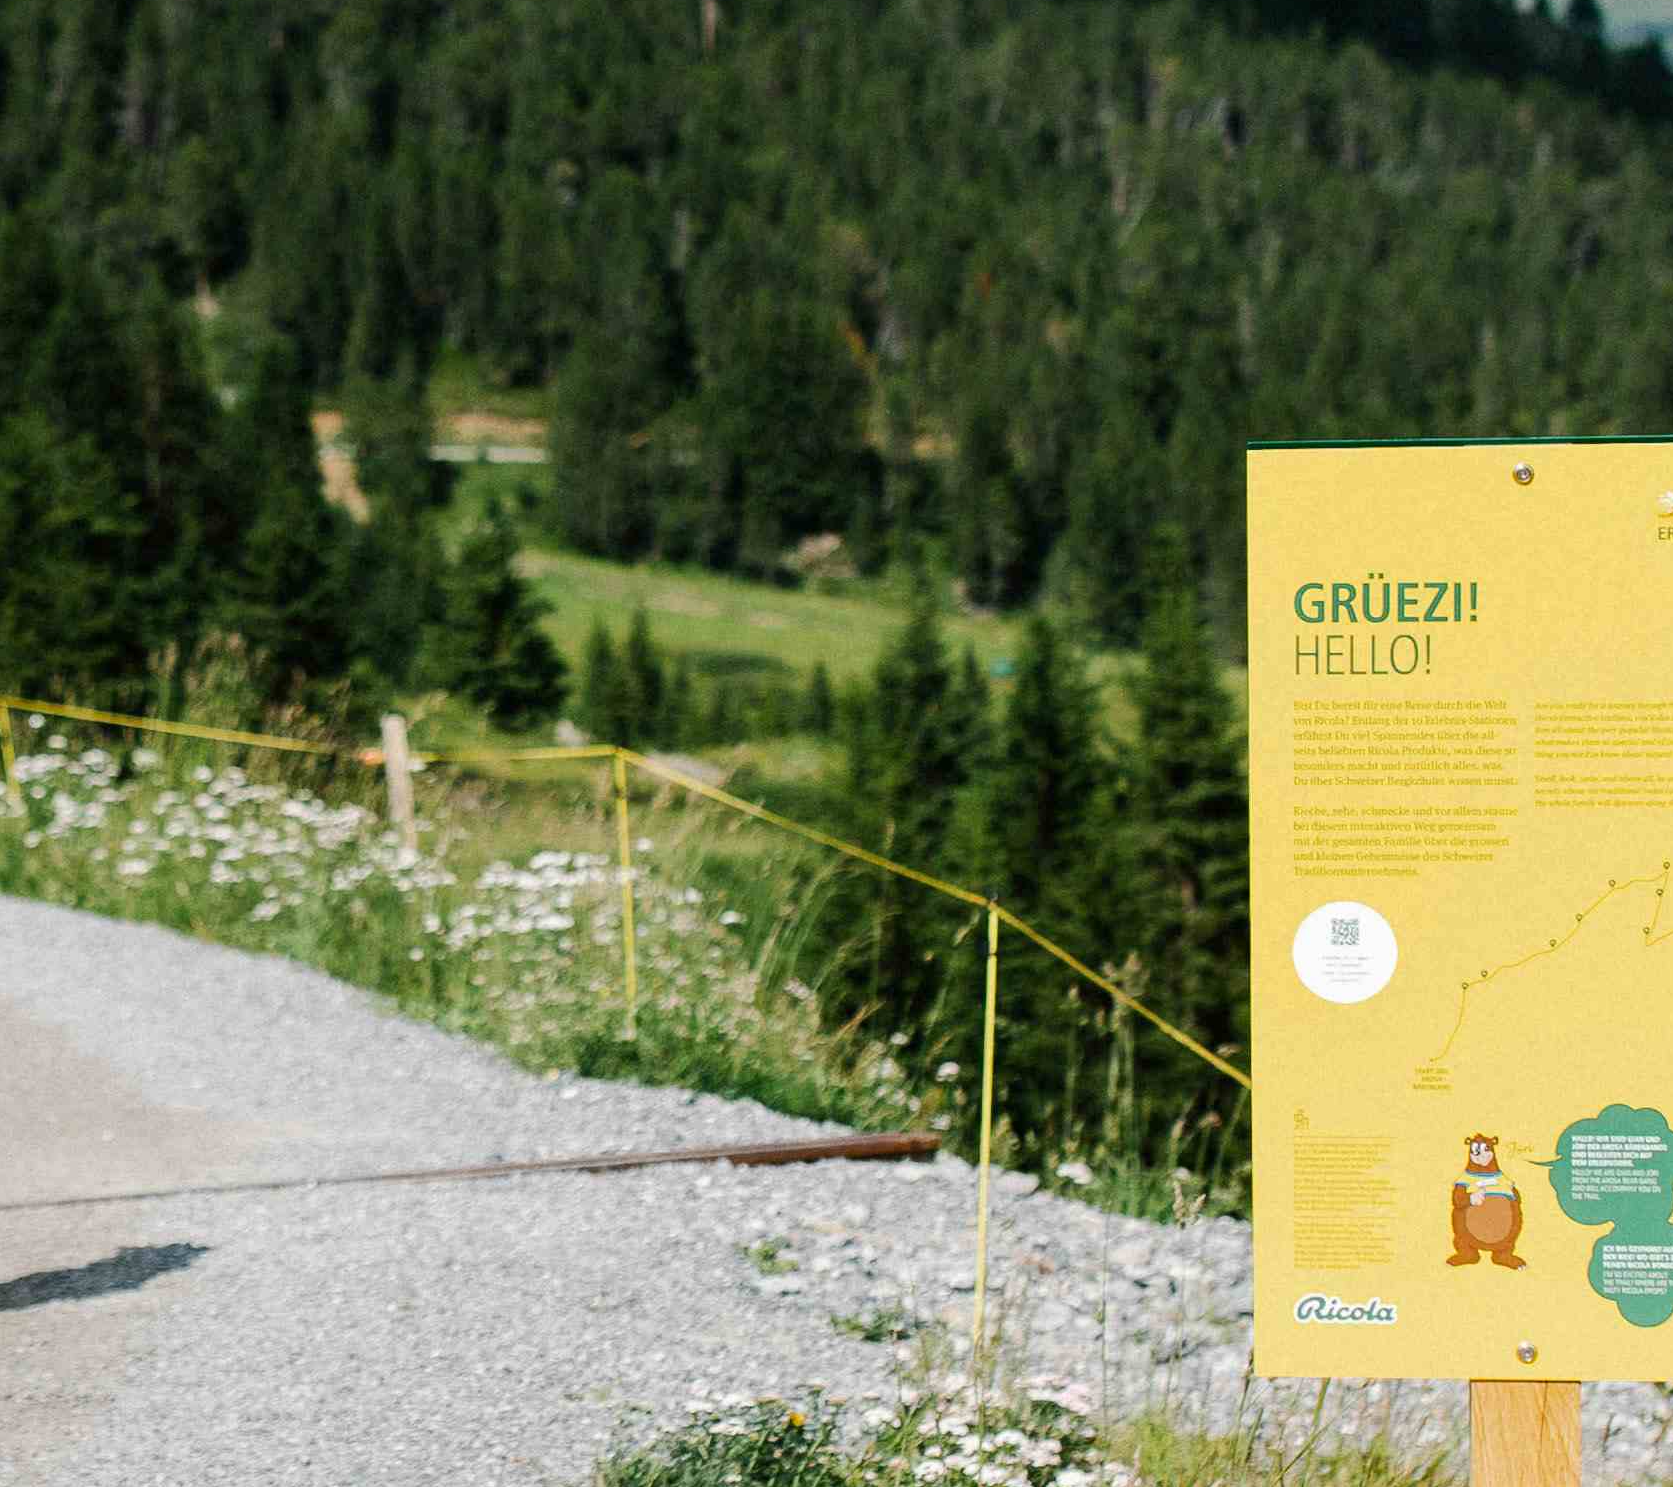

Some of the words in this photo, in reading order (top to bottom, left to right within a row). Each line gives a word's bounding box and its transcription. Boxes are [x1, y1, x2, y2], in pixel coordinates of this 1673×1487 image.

[1294, 572, 1479, 623] GRÜEZI!
[1295, 634, 1432, 675] HELLO!
[1465, 700, 1482, 710] die
[1485, 700, 1507, 710] Welt
[1462, 731, 1480, 742] die
[1413, 806, 1434, 816] und
[1296, 1295, 1394, 1322] Ricola
